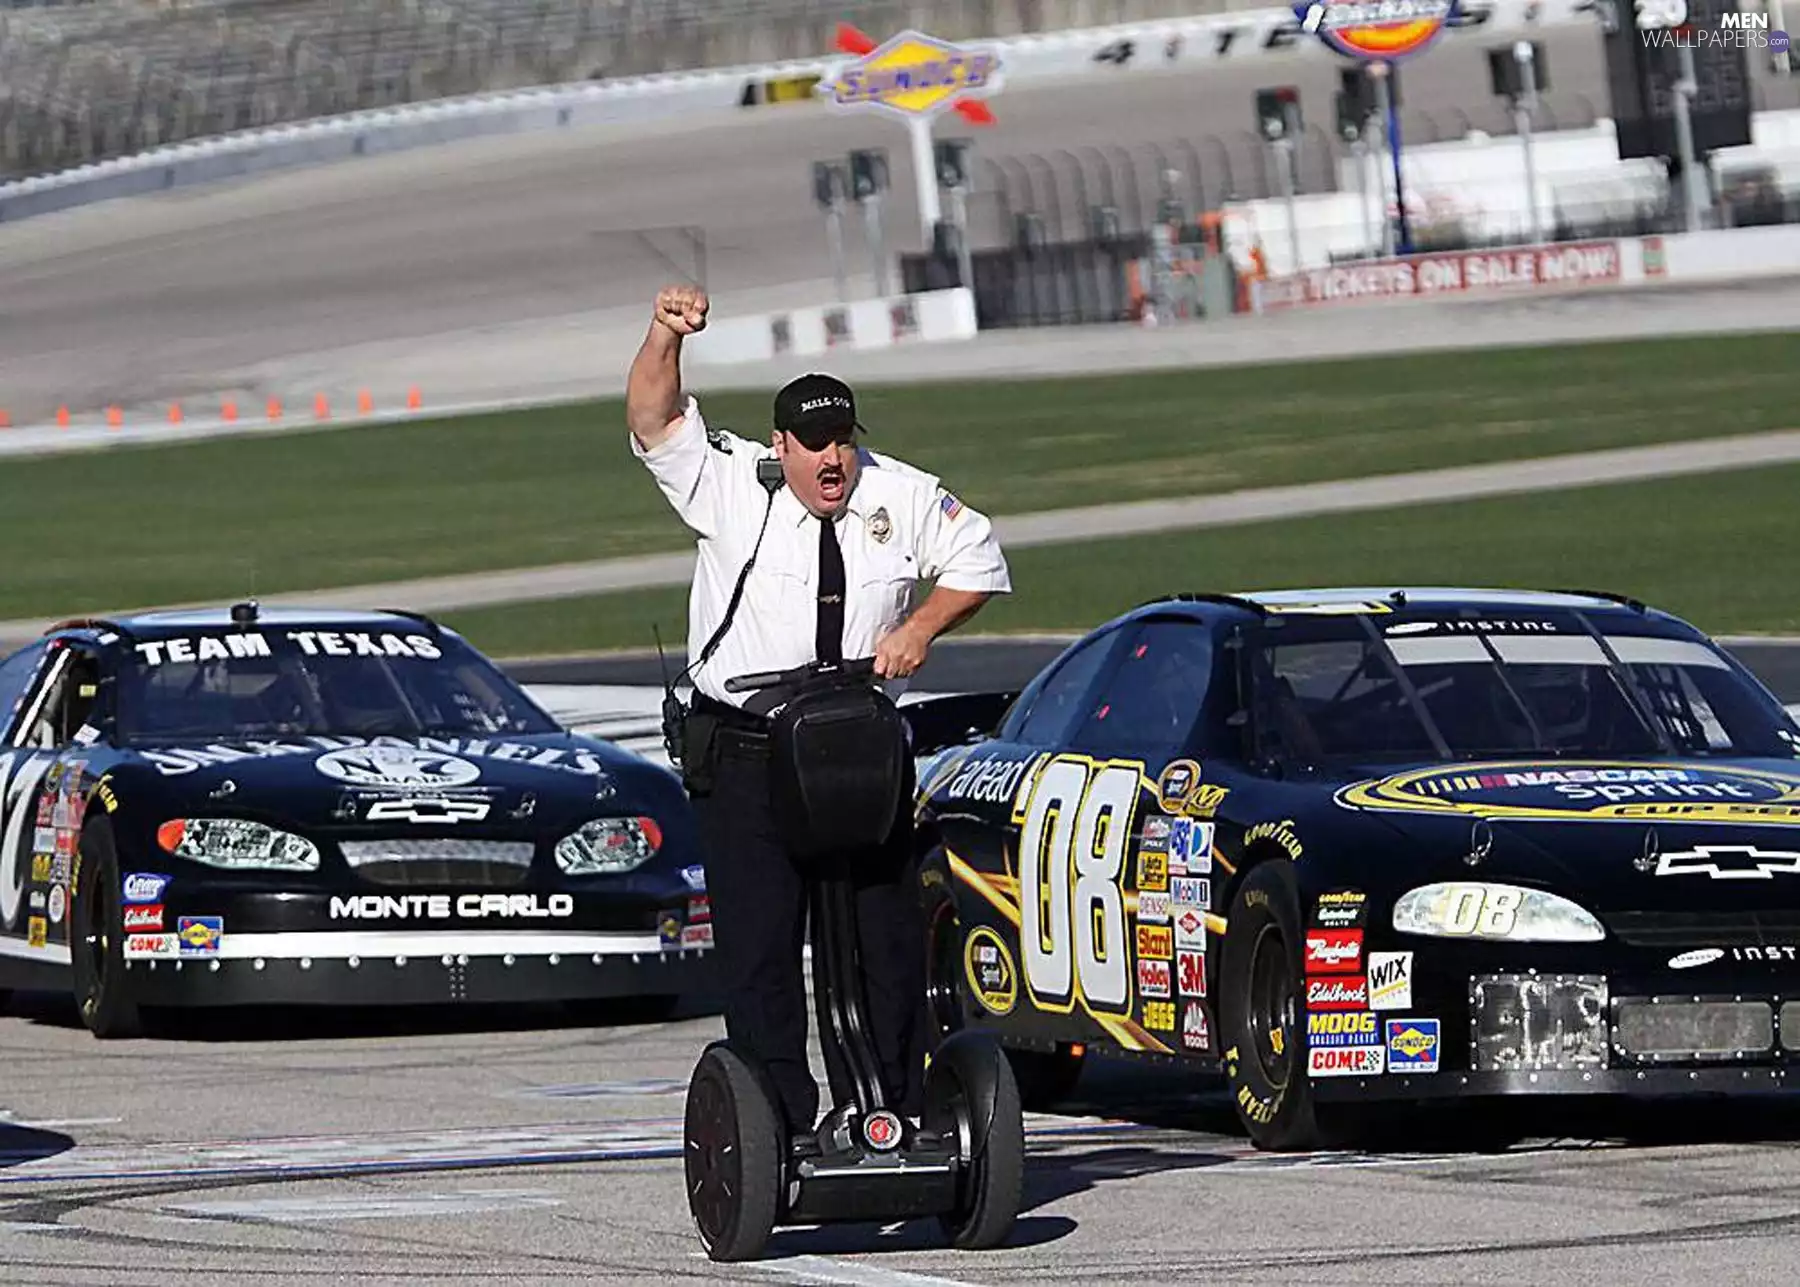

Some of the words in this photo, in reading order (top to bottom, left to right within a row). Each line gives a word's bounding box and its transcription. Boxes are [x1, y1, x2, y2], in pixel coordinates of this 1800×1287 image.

[1305, 262, 1414, 300] TICKETS
[1417, 257, 1462, 292] ON
[1464, 252, 1534, 288] SALE
[135, 632, 271, 667] TEAM
[286, 631, 442, 660] TEXAS
[947, 751, 1037, 803] ahead
[1503, 769, 1690, 788] NASCAR
[1554, 782, 1753, 802] Sprint
[1016, 756, 1143, 1014] 08
[329, 894, 451, 919] MONTE
[456, 893, 574, 917] CARLO
[1444, 885, 1525, 936] 08
[1178, 952, 1206, 995] 3M
[1370, 955, 1408, 989] WIX
[1308, 1012, 1377, 1035] MOOG
[1392, 1035, 1437, 1050] SUNOCO
[1311, 1050, 1366, 1070] COMP
